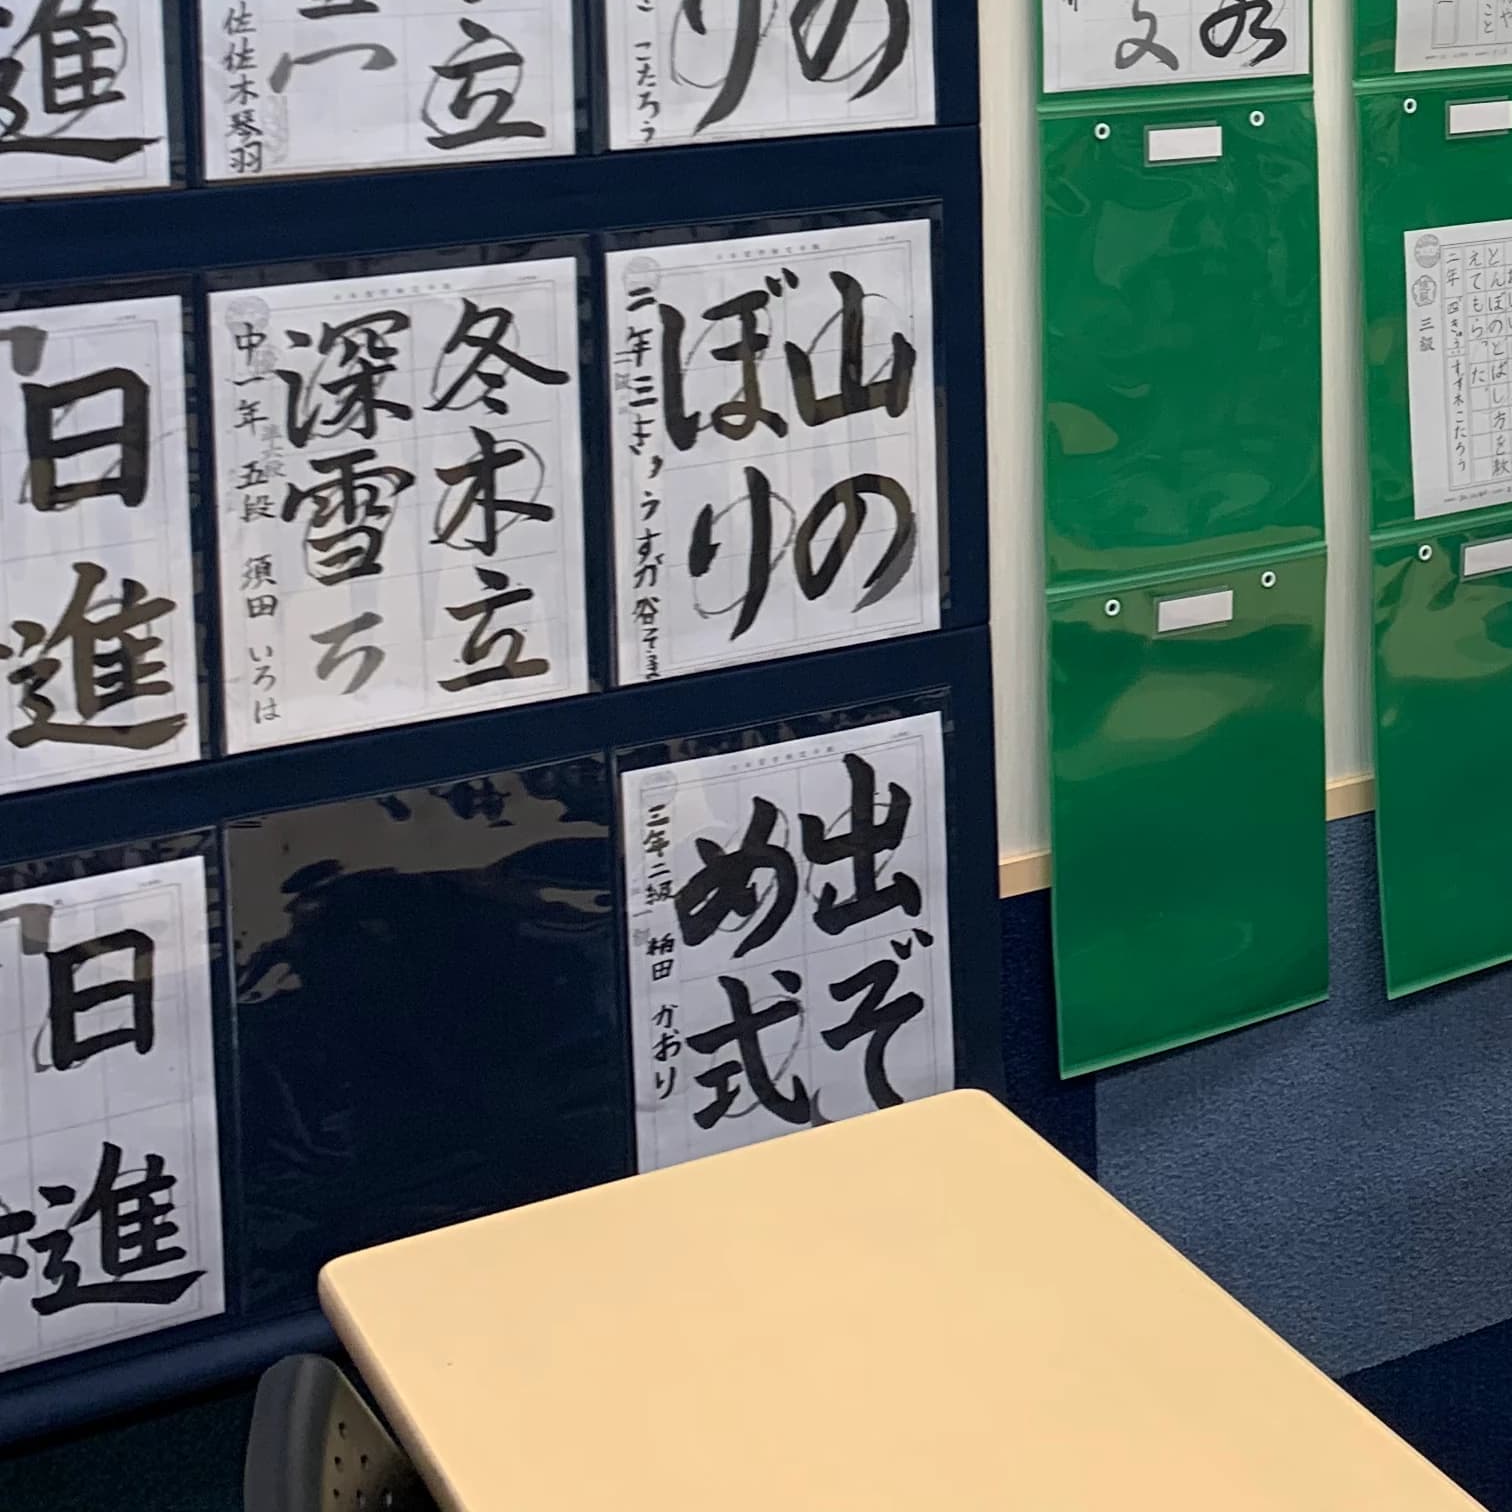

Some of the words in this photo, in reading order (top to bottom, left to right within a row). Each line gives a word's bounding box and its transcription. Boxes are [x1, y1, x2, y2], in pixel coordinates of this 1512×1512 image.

[232, 323, 269, 434] 中一年
[273, 310, 415, 586] 深雪
[659, 268, 800, 640] ぼり
[785, 270, 917, 613] 山の
[1419, 317, 1435, 353] 三級
[8, 367, 188, 751] 日進
[235, 461, 276, 522] 五段
[240, 554, 278, 618] 須田
[424, 298, 570, 692] 冬木立
[250, 645, 281, 724] いろは
[650, 1002, 682, 1101] かおり
[675, 796, 812, 1129] め式
[798, 752, 934, 1109] 出ぞ
[27, 928, 209, 1316] 日進
